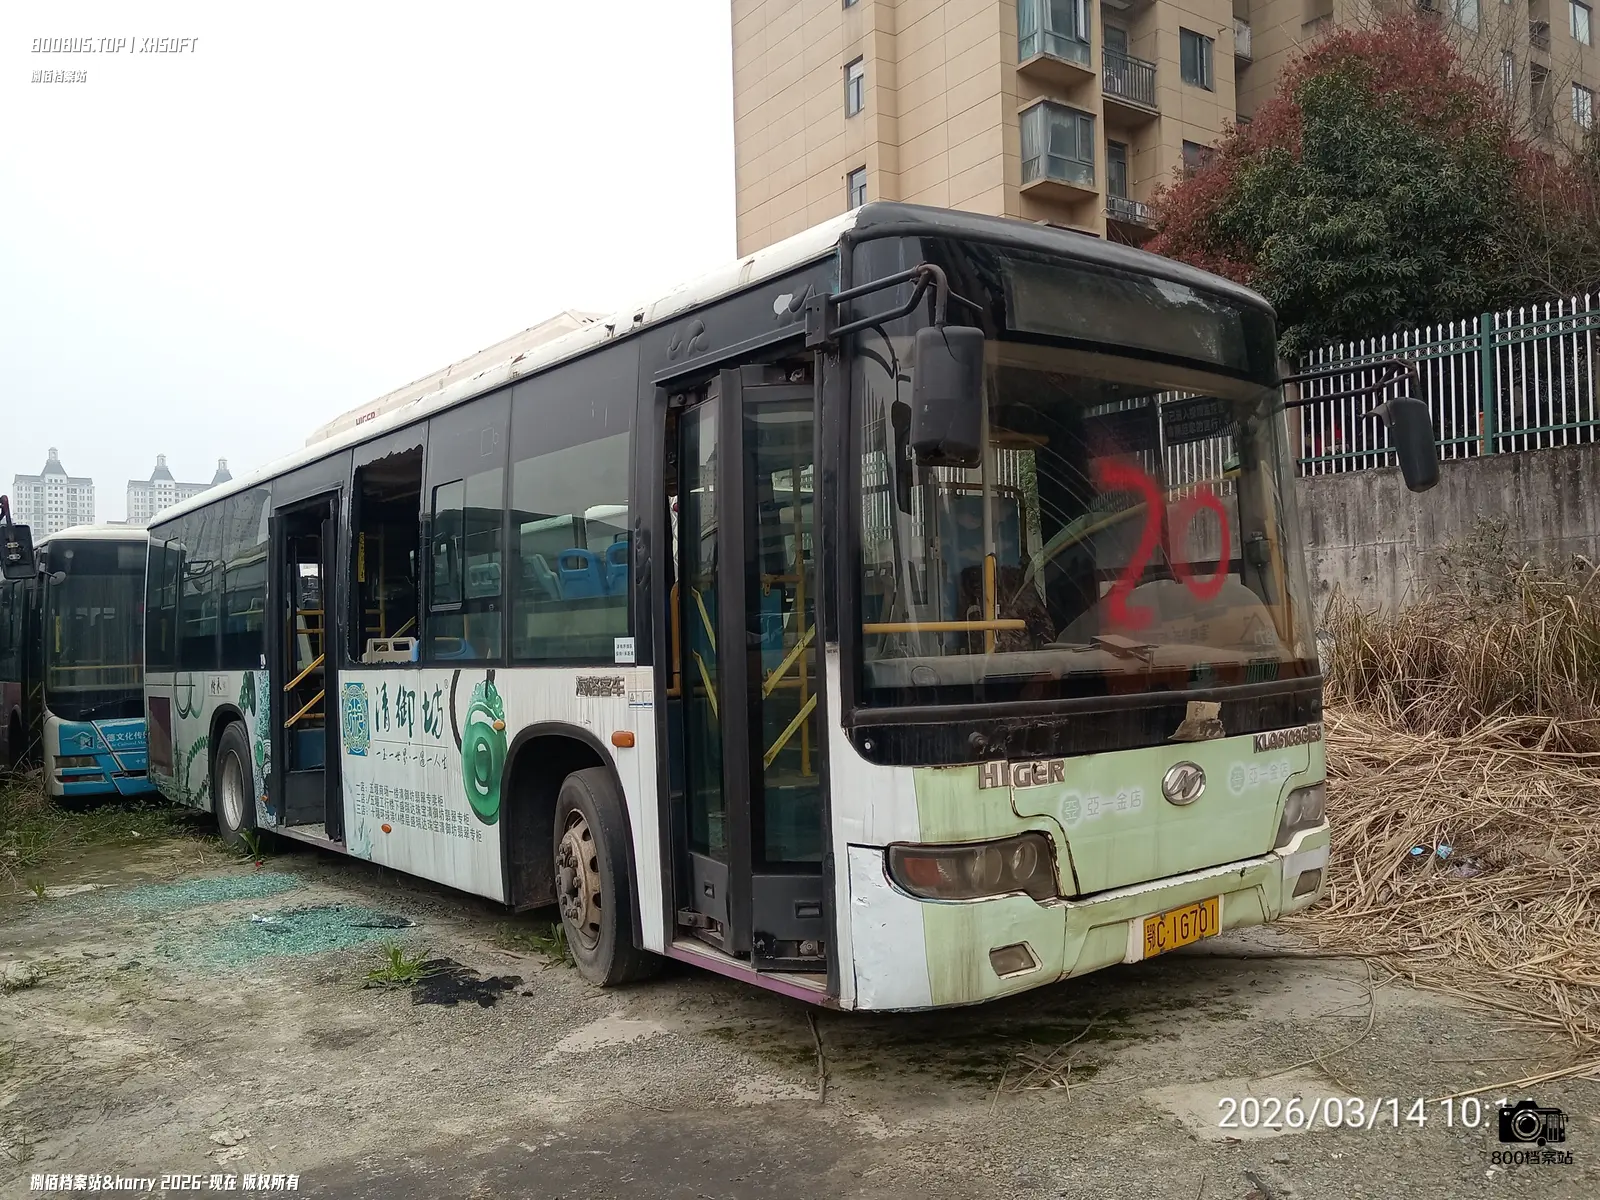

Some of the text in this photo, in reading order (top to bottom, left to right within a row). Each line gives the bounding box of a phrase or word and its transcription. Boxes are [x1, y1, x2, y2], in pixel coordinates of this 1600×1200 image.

[1097, 460, 1228, 625] 20
[979, 759, 1065, 789] HIGER
[1147, 905, 1215, 951] 鄂C·1G701
